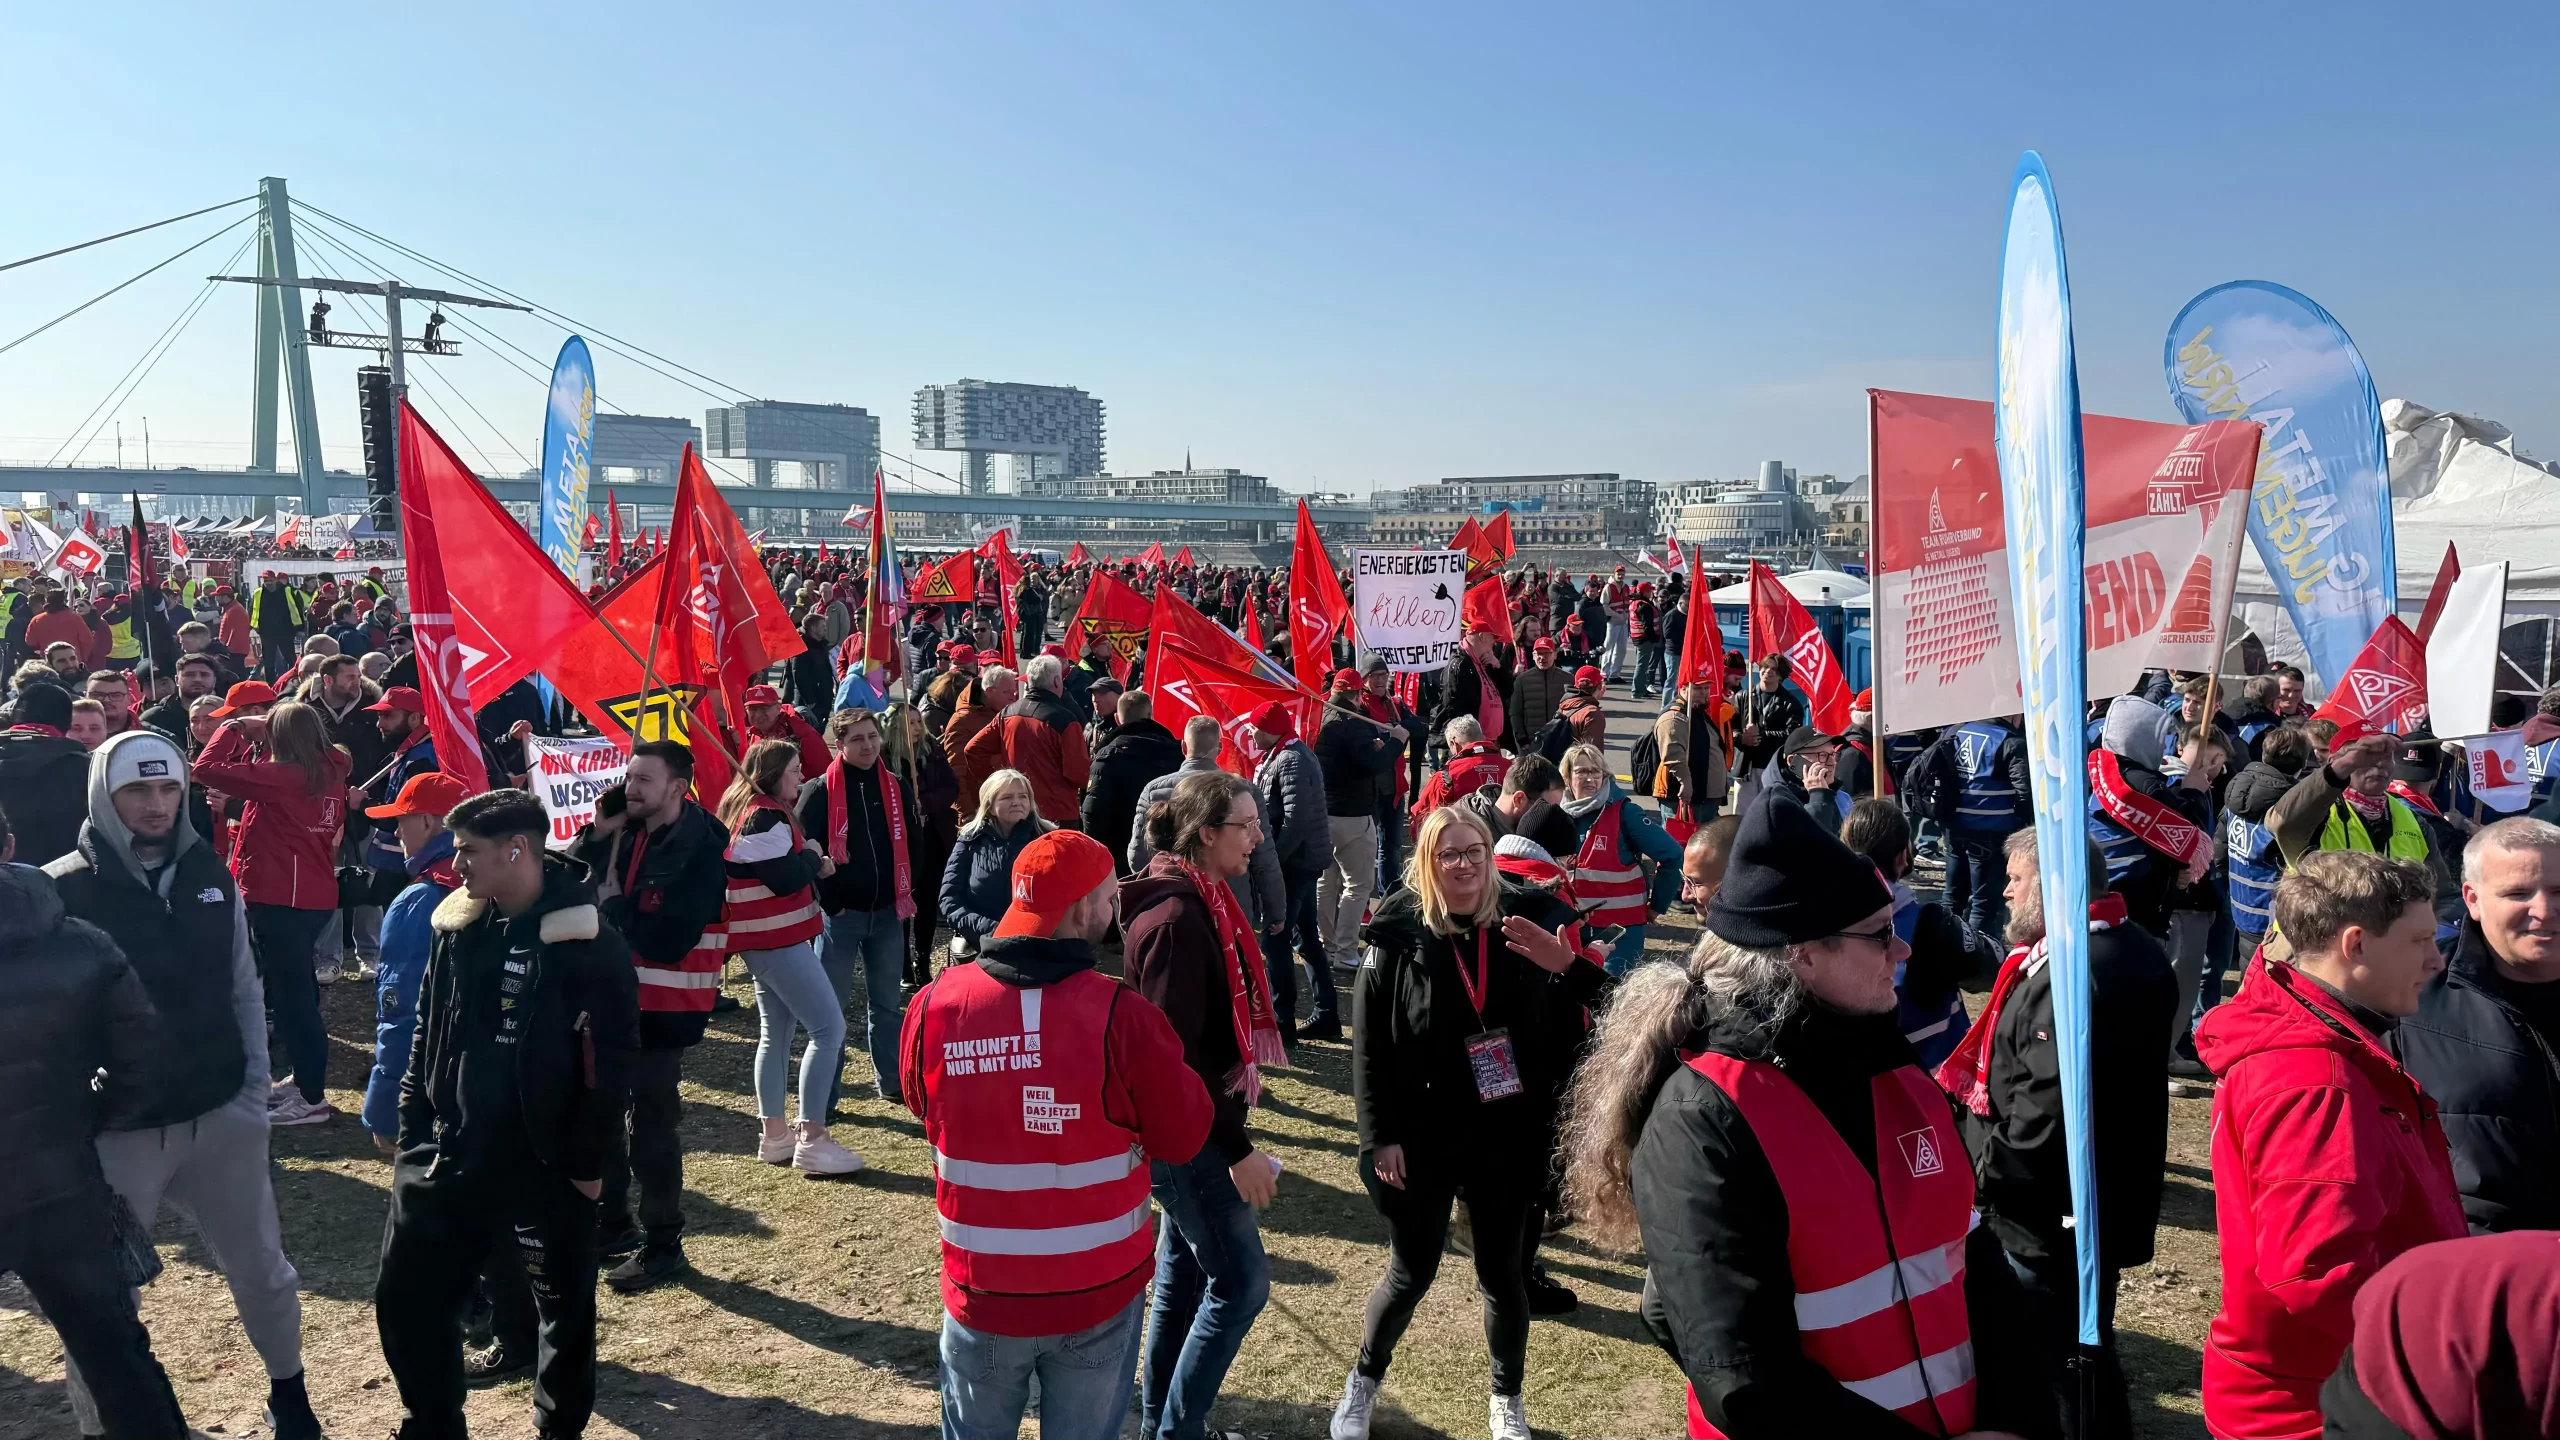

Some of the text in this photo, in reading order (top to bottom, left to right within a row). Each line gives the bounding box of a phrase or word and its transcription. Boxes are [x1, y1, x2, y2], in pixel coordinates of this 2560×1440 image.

[2172, 456, 2201, 480] JETZT
[2149, 487, 2185, 513] ZÄHLT.
[1921, 527, 1982, 549] TEAM RUHRVERBUND
[1360, 554, 1465, 575] ENERGIEKOSTEN
[1370, 592, 1448, 632] killen
[2085, 551, 2167, 652] END
[504, 961, 526, 975] NIKE
[943, 1036, 1020, 1060] ZUKUNFT
[946, 1053, 1041, 1077] NUR MIT UNS
[1026, 1090, 1051, 1101] WEIL
[1483, 1091, 1492, 1100] IG
[1493, 1084, 1520, 1097] METALL
[1026, 1106, 1077, 1117] DAS JETZT
[1027, 1120, 1060, 1132] ZÄHLT.
